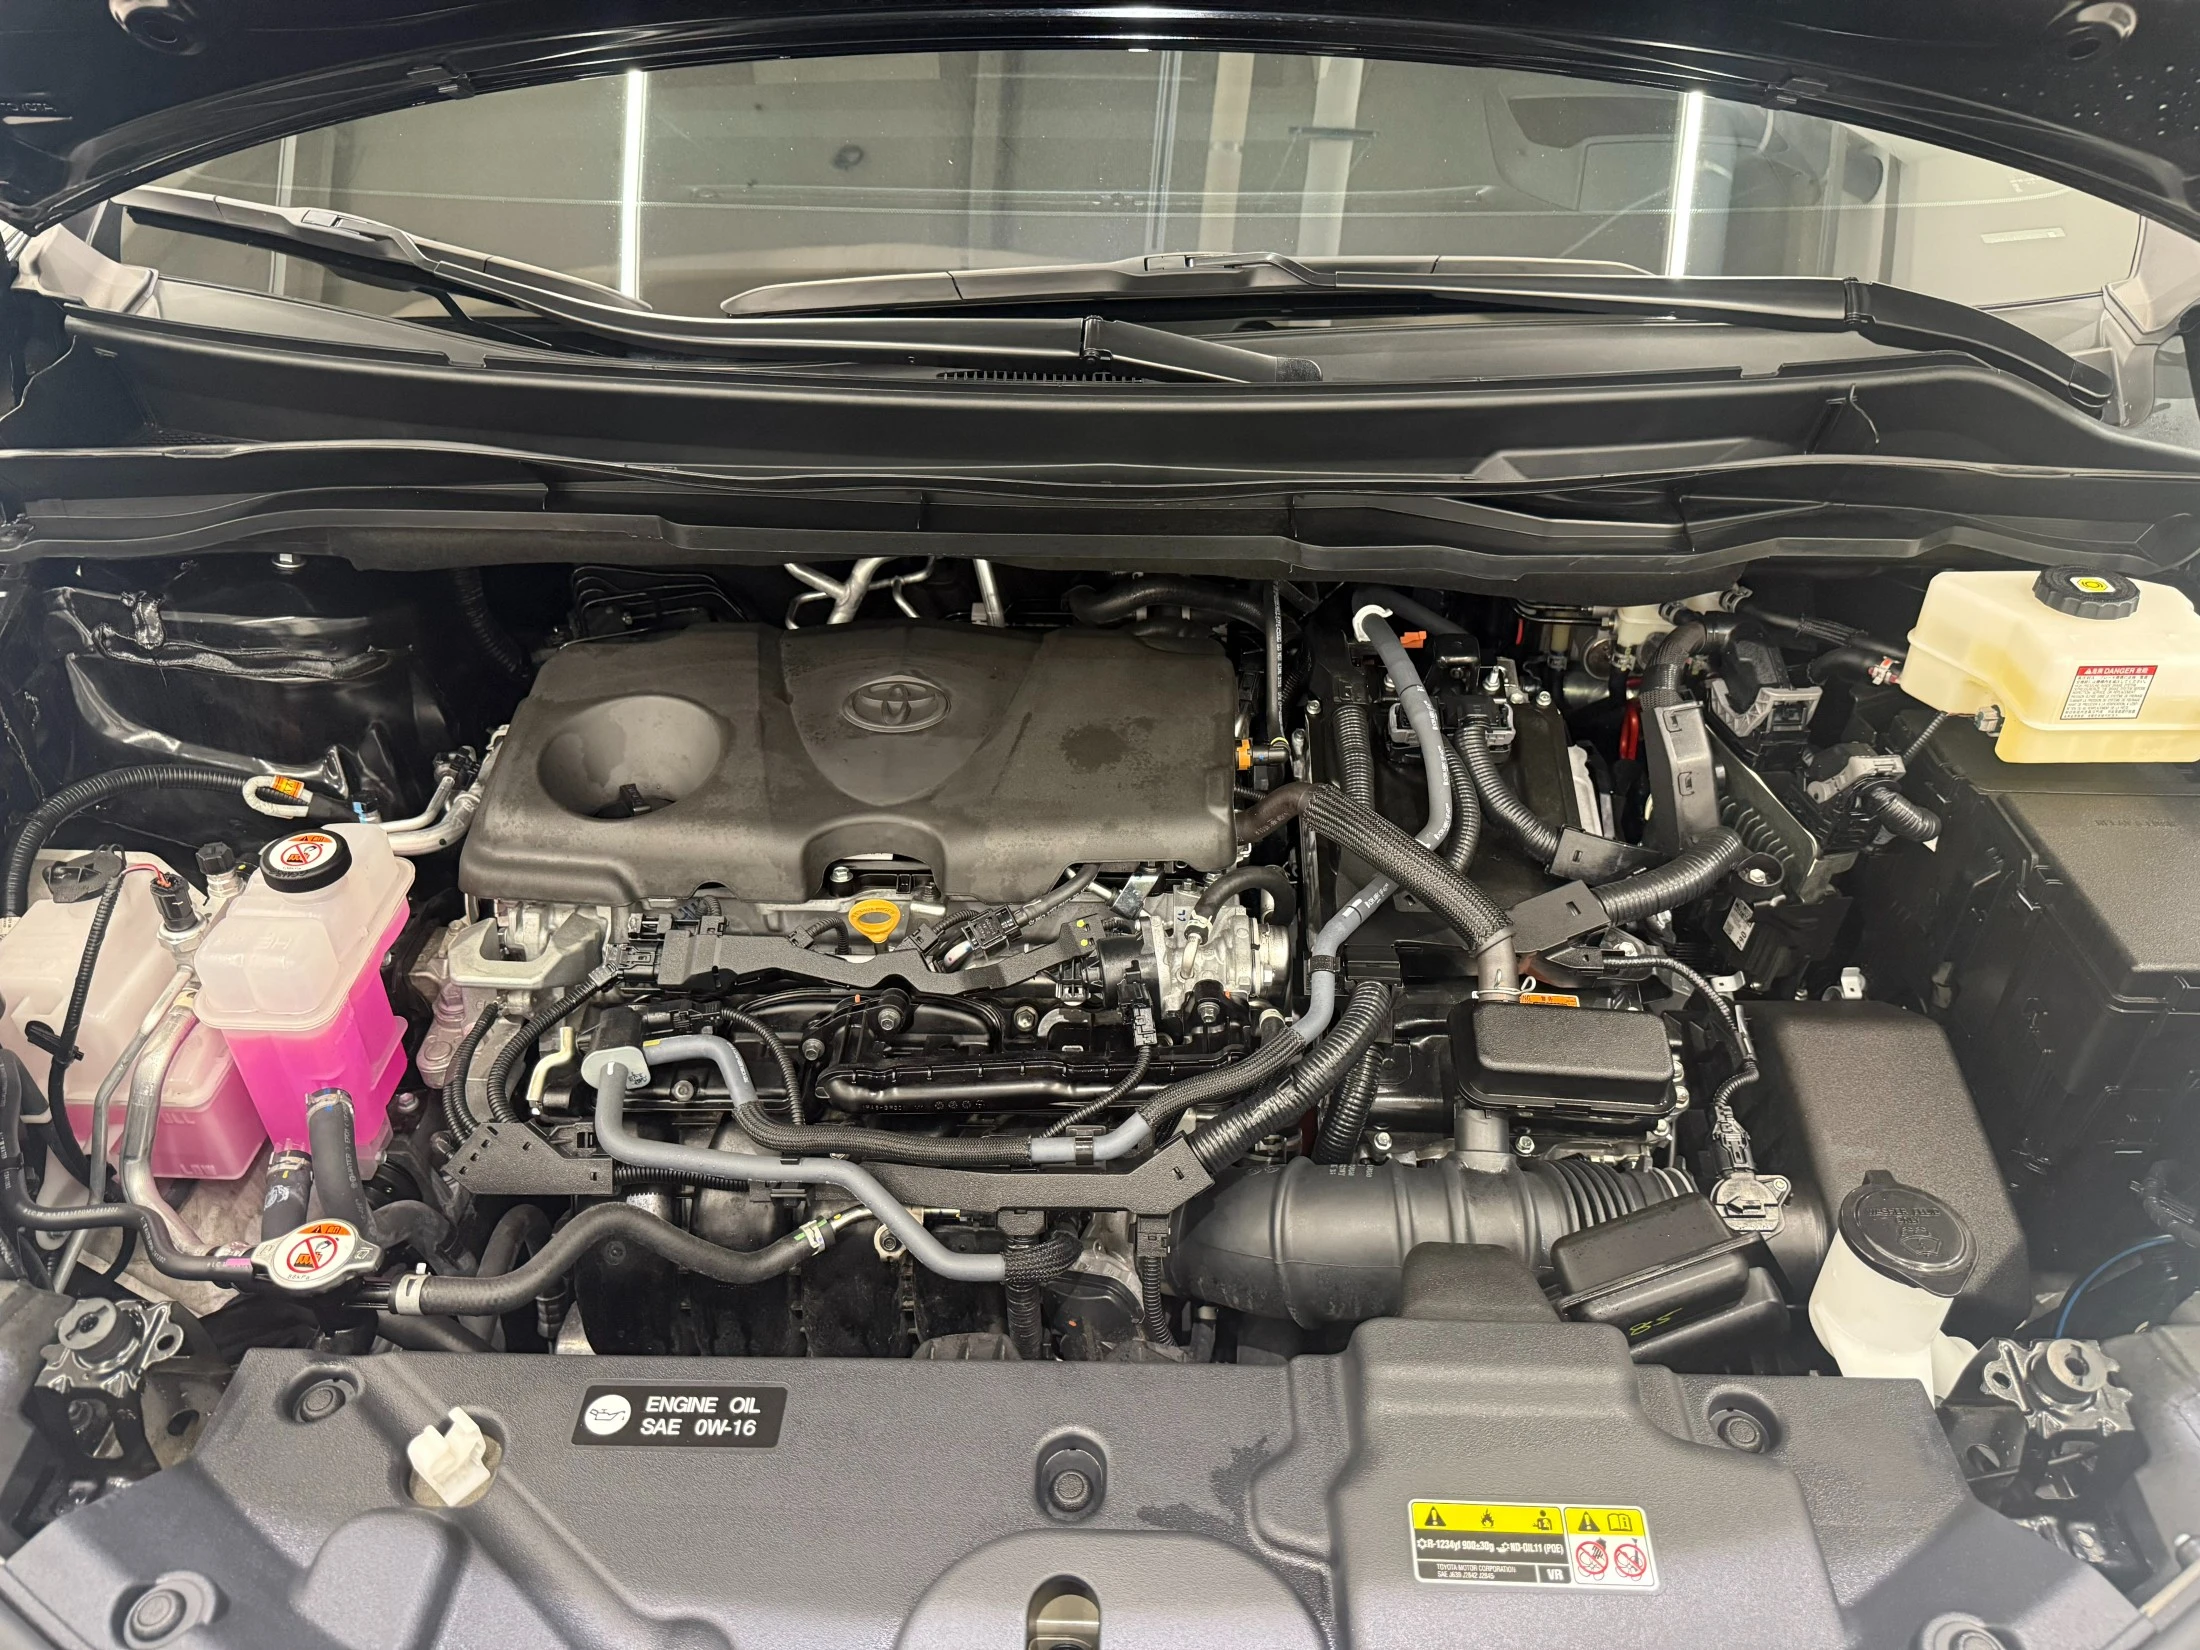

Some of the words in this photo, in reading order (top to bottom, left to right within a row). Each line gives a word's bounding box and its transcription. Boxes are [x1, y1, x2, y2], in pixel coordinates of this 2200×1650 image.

[645, 1395, 719, 1413] ENGINE
[729, 1396, 761, 1414] OIL
[640, 1418, 683, 1435] SAE
[694, 1418, 757, 1436] 0W-16
[1543, 1543, 1564, 1555] (POE)
[1436, 1563, 1458, 1571] TOYOTA
[1458, 1564, 1478, 1572] MOTOR
[1478, 1564, 1517, 1573] CORPORATION
[1437, 1570, 1448, 1578] SAE
[1546, 1568, 1564, 1581] VR
